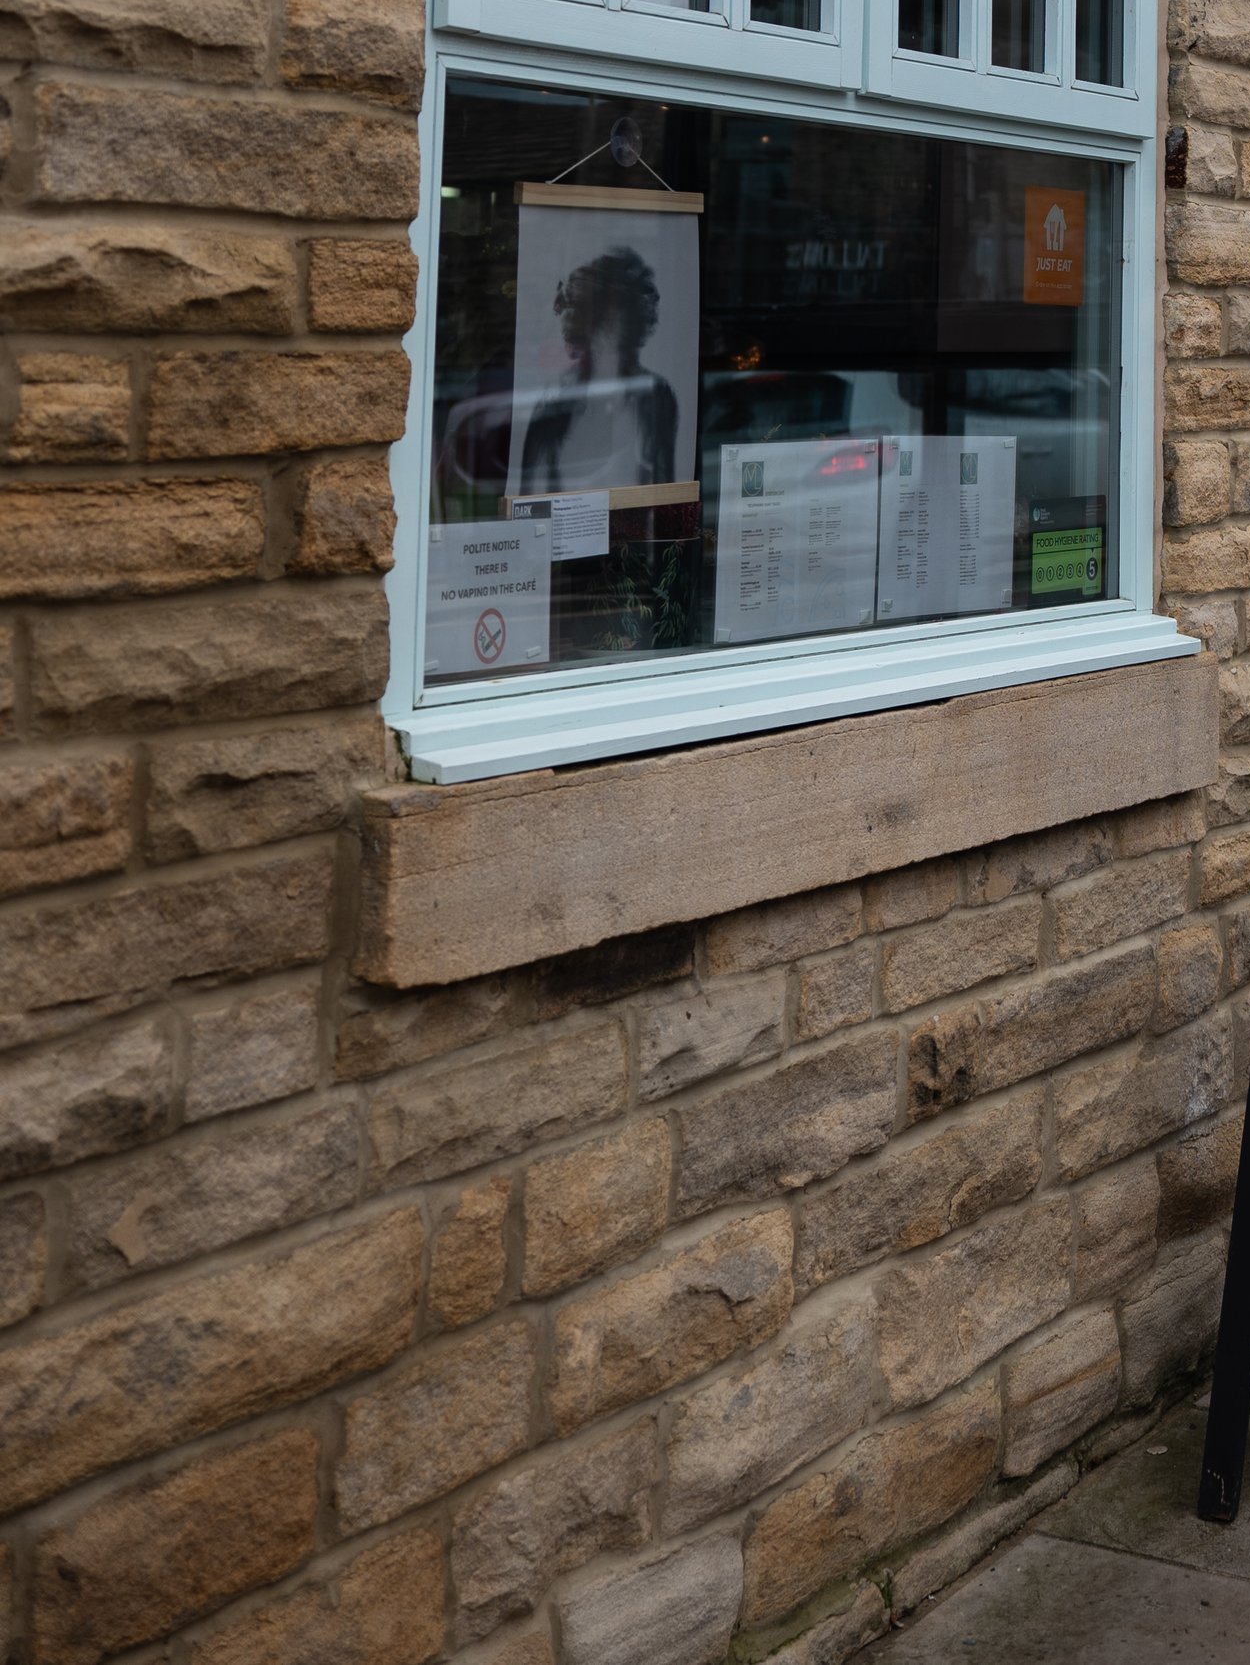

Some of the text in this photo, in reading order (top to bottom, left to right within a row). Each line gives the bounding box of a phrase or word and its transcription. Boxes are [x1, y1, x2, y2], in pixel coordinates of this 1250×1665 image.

[1036, 257, 1073, 272] JUST EAT
[515, 505, 533, 517] DARK
[463, 539, 520, 555] POLITE NOTICE
[1036, 533, 1099, 548] FOOD HYGIENE RATING
[474, 562, 508, 575] THERE IS
[1088, 560, 1095, 577] 5
[441, 578, 537, 601] NO VAPING IN THE CAFÉ
